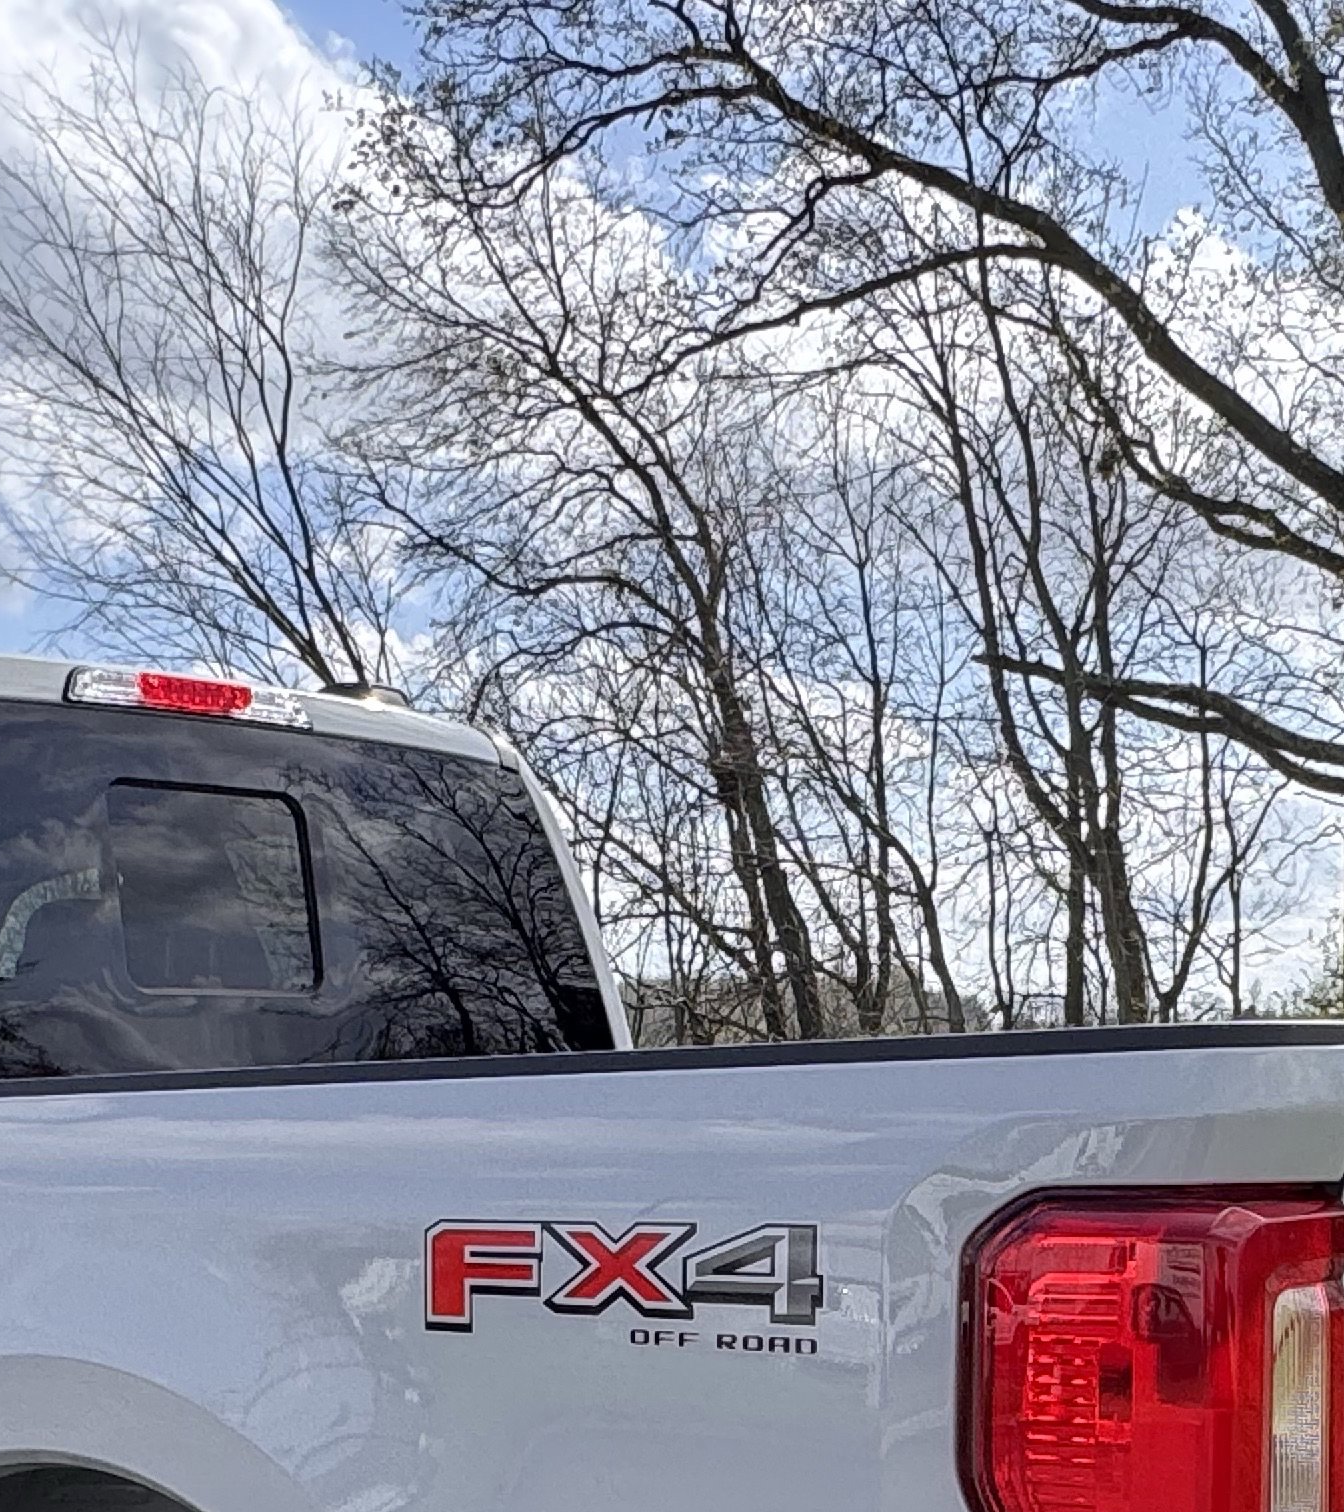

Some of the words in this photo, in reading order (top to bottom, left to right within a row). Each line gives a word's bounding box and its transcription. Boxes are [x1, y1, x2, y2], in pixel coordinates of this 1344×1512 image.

[425, 1219, 823, 1333] FX4
[630, 1328, 700, 1348] OFF
[716, 1333, 818, 1355] ROAD
